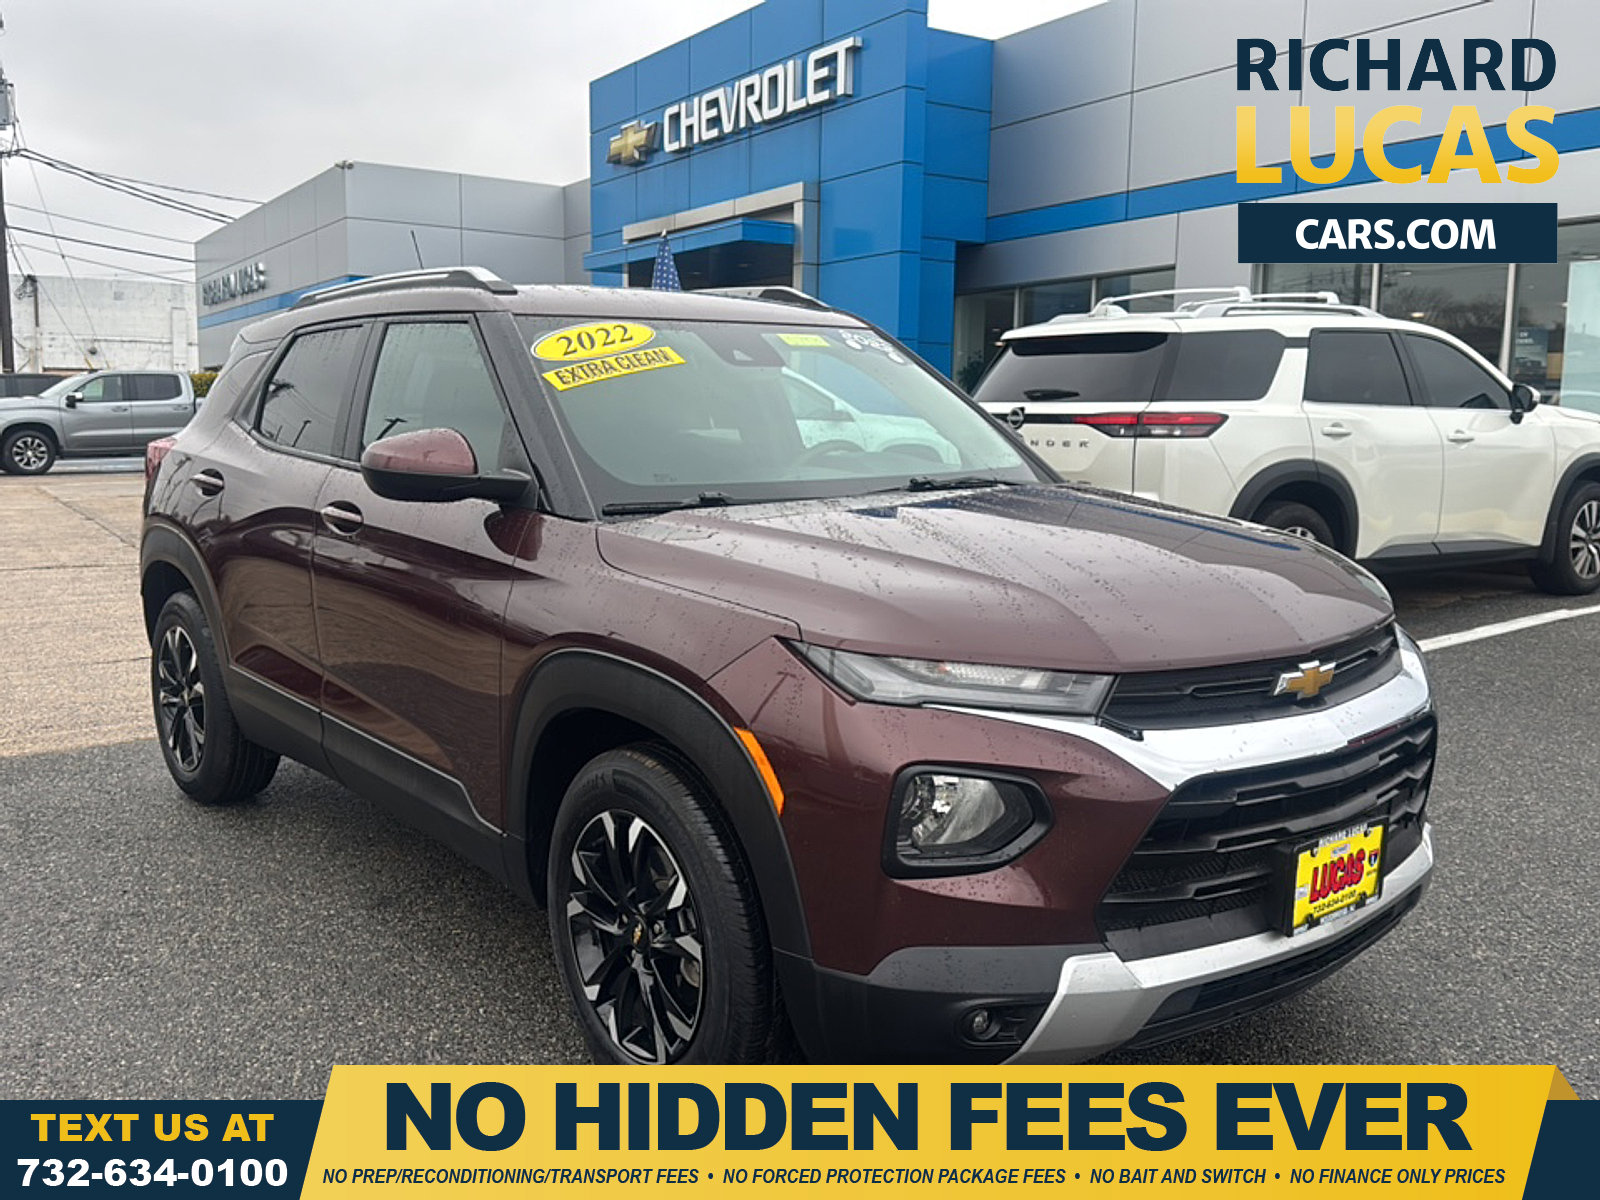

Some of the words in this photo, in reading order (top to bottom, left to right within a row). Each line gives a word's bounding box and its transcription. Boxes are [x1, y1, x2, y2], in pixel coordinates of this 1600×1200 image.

[663, 35, 861, 154] CHEVROLET
[556, 324, 634, 356] 2022
[554, 359, 617, 385] EXTRA
[614, 348, 673, 371] CLEAN
[1309, 848, 1366, 905] LUCAS
